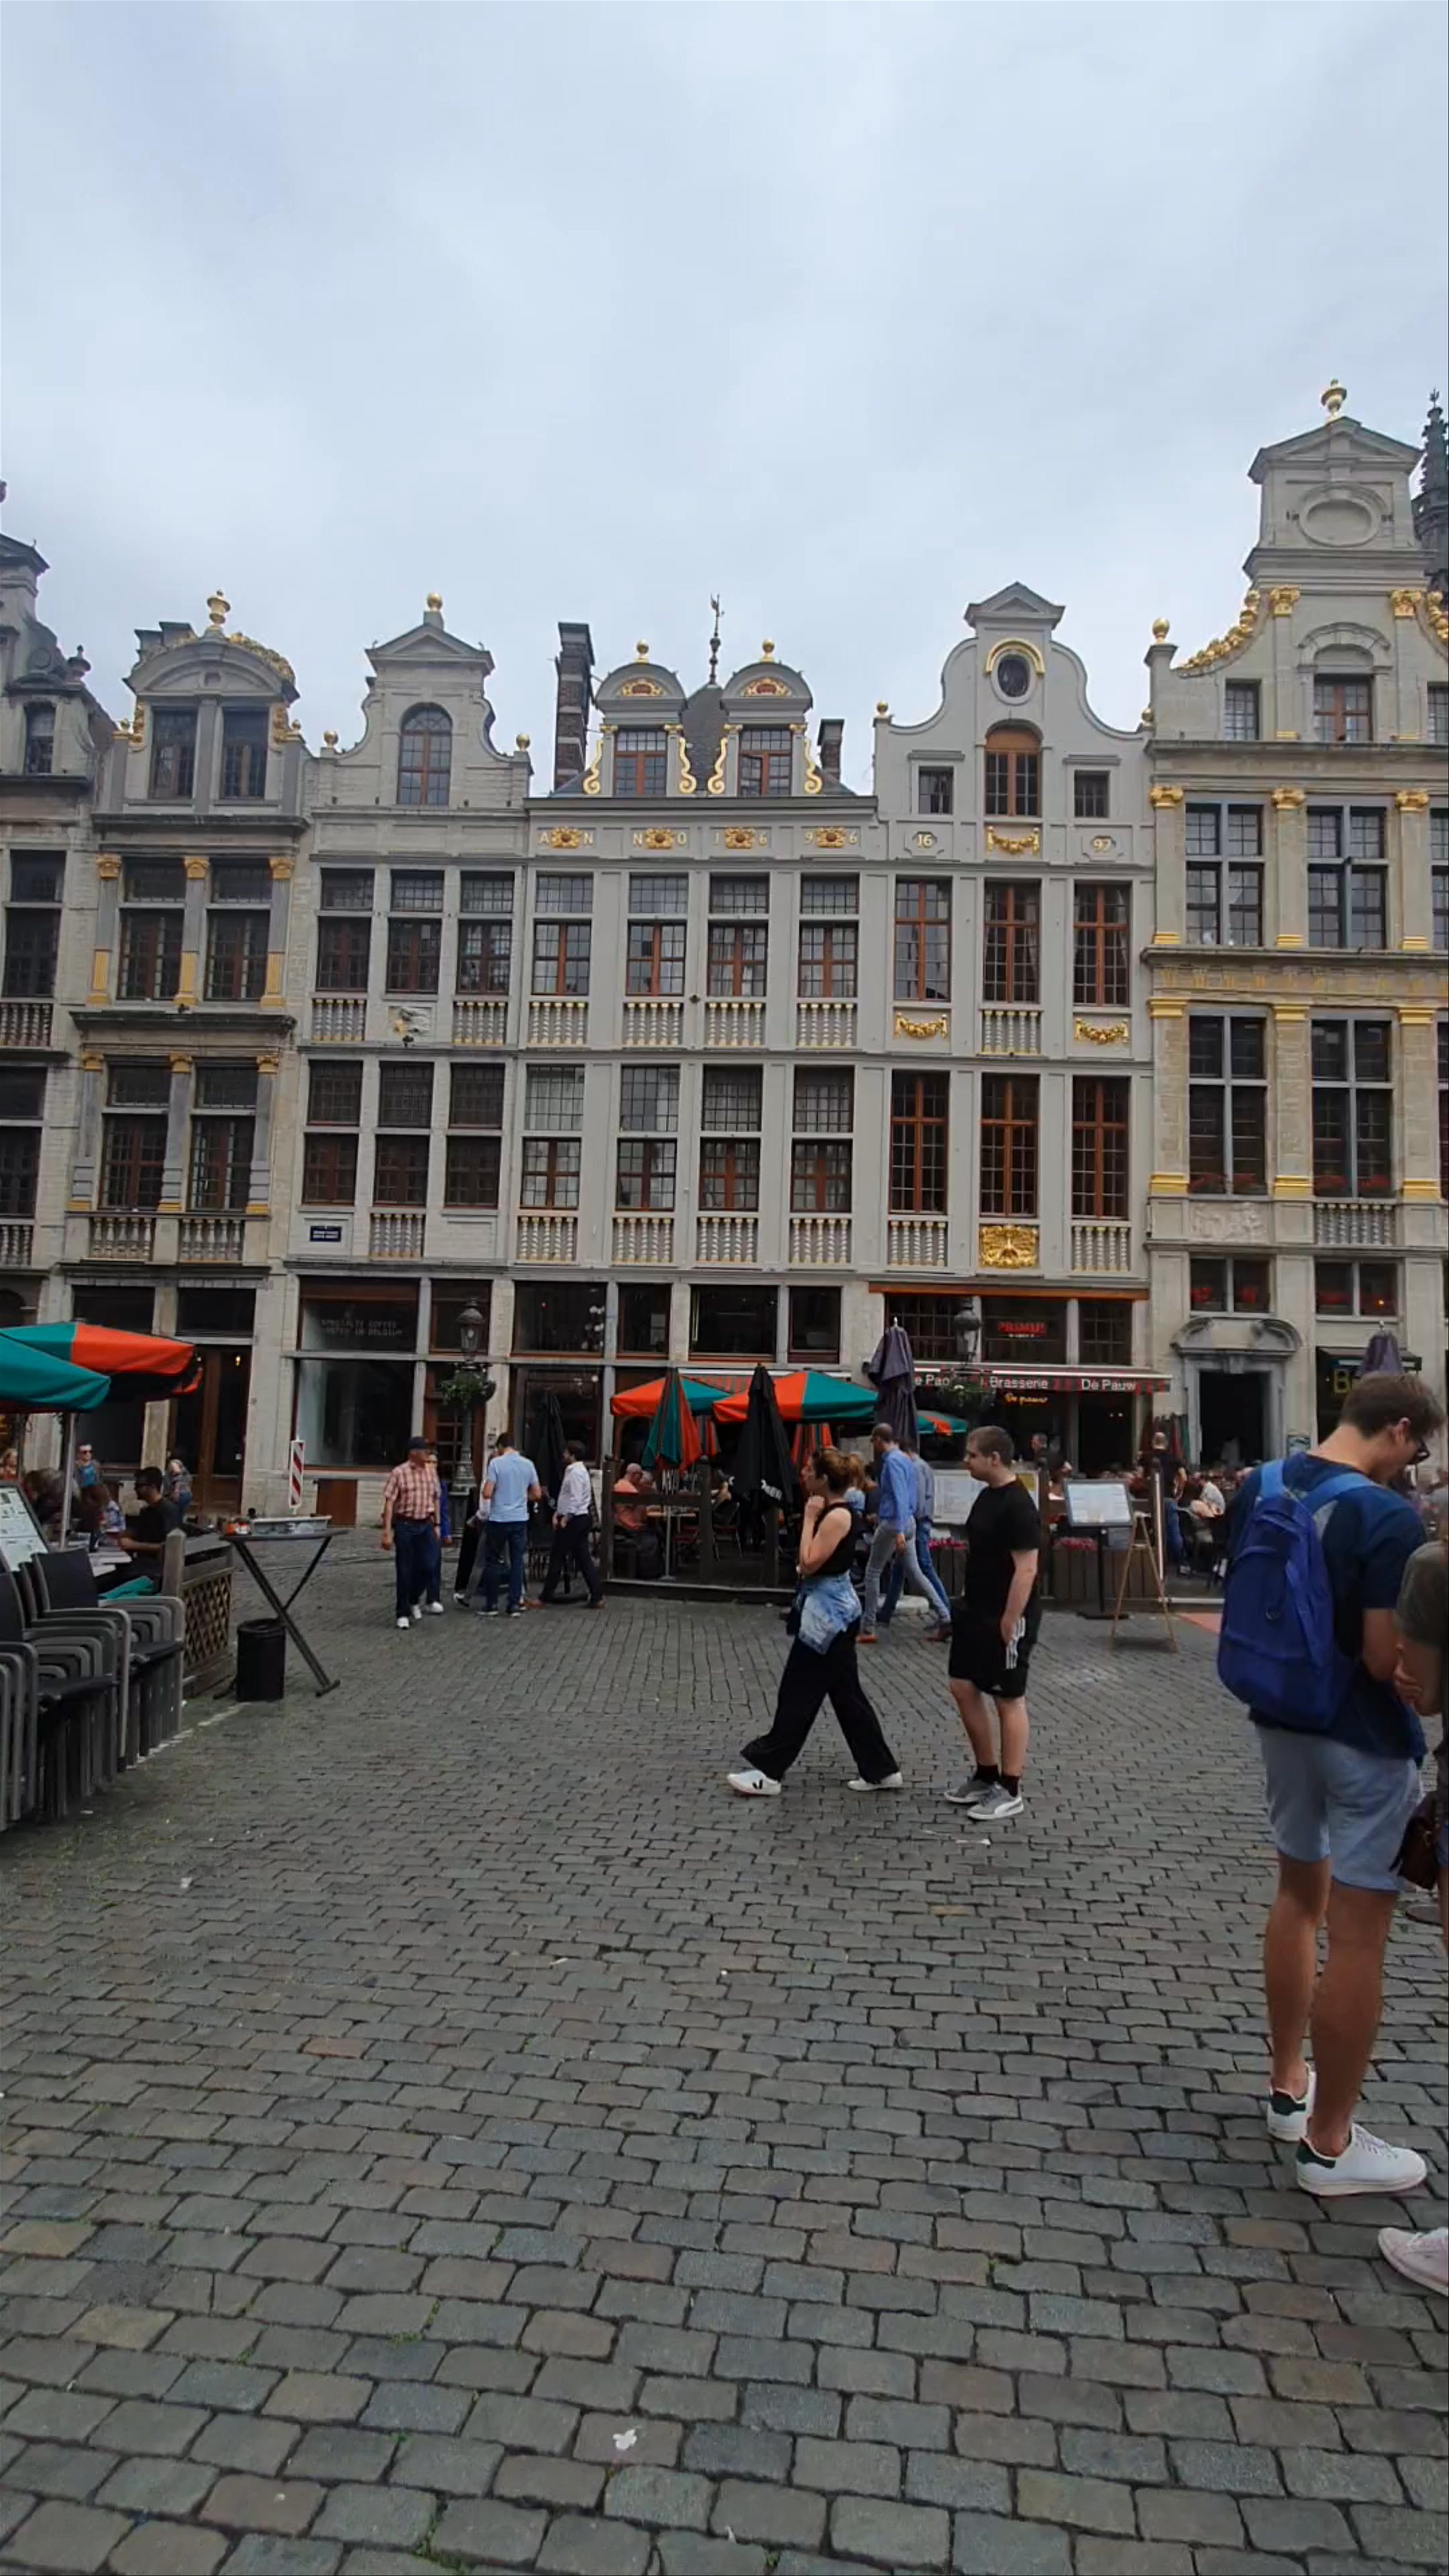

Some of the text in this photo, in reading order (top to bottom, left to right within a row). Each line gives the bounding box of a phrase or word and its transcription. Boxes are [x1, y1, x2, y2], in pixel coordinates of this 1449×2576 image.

[917, 834, 932, 846] 16
[926, 1375, 950, 1386] Pao
[990, 1376, 1048, 1389] Brasserie
[1081, 1378, 1137, 1390] De Pauw
